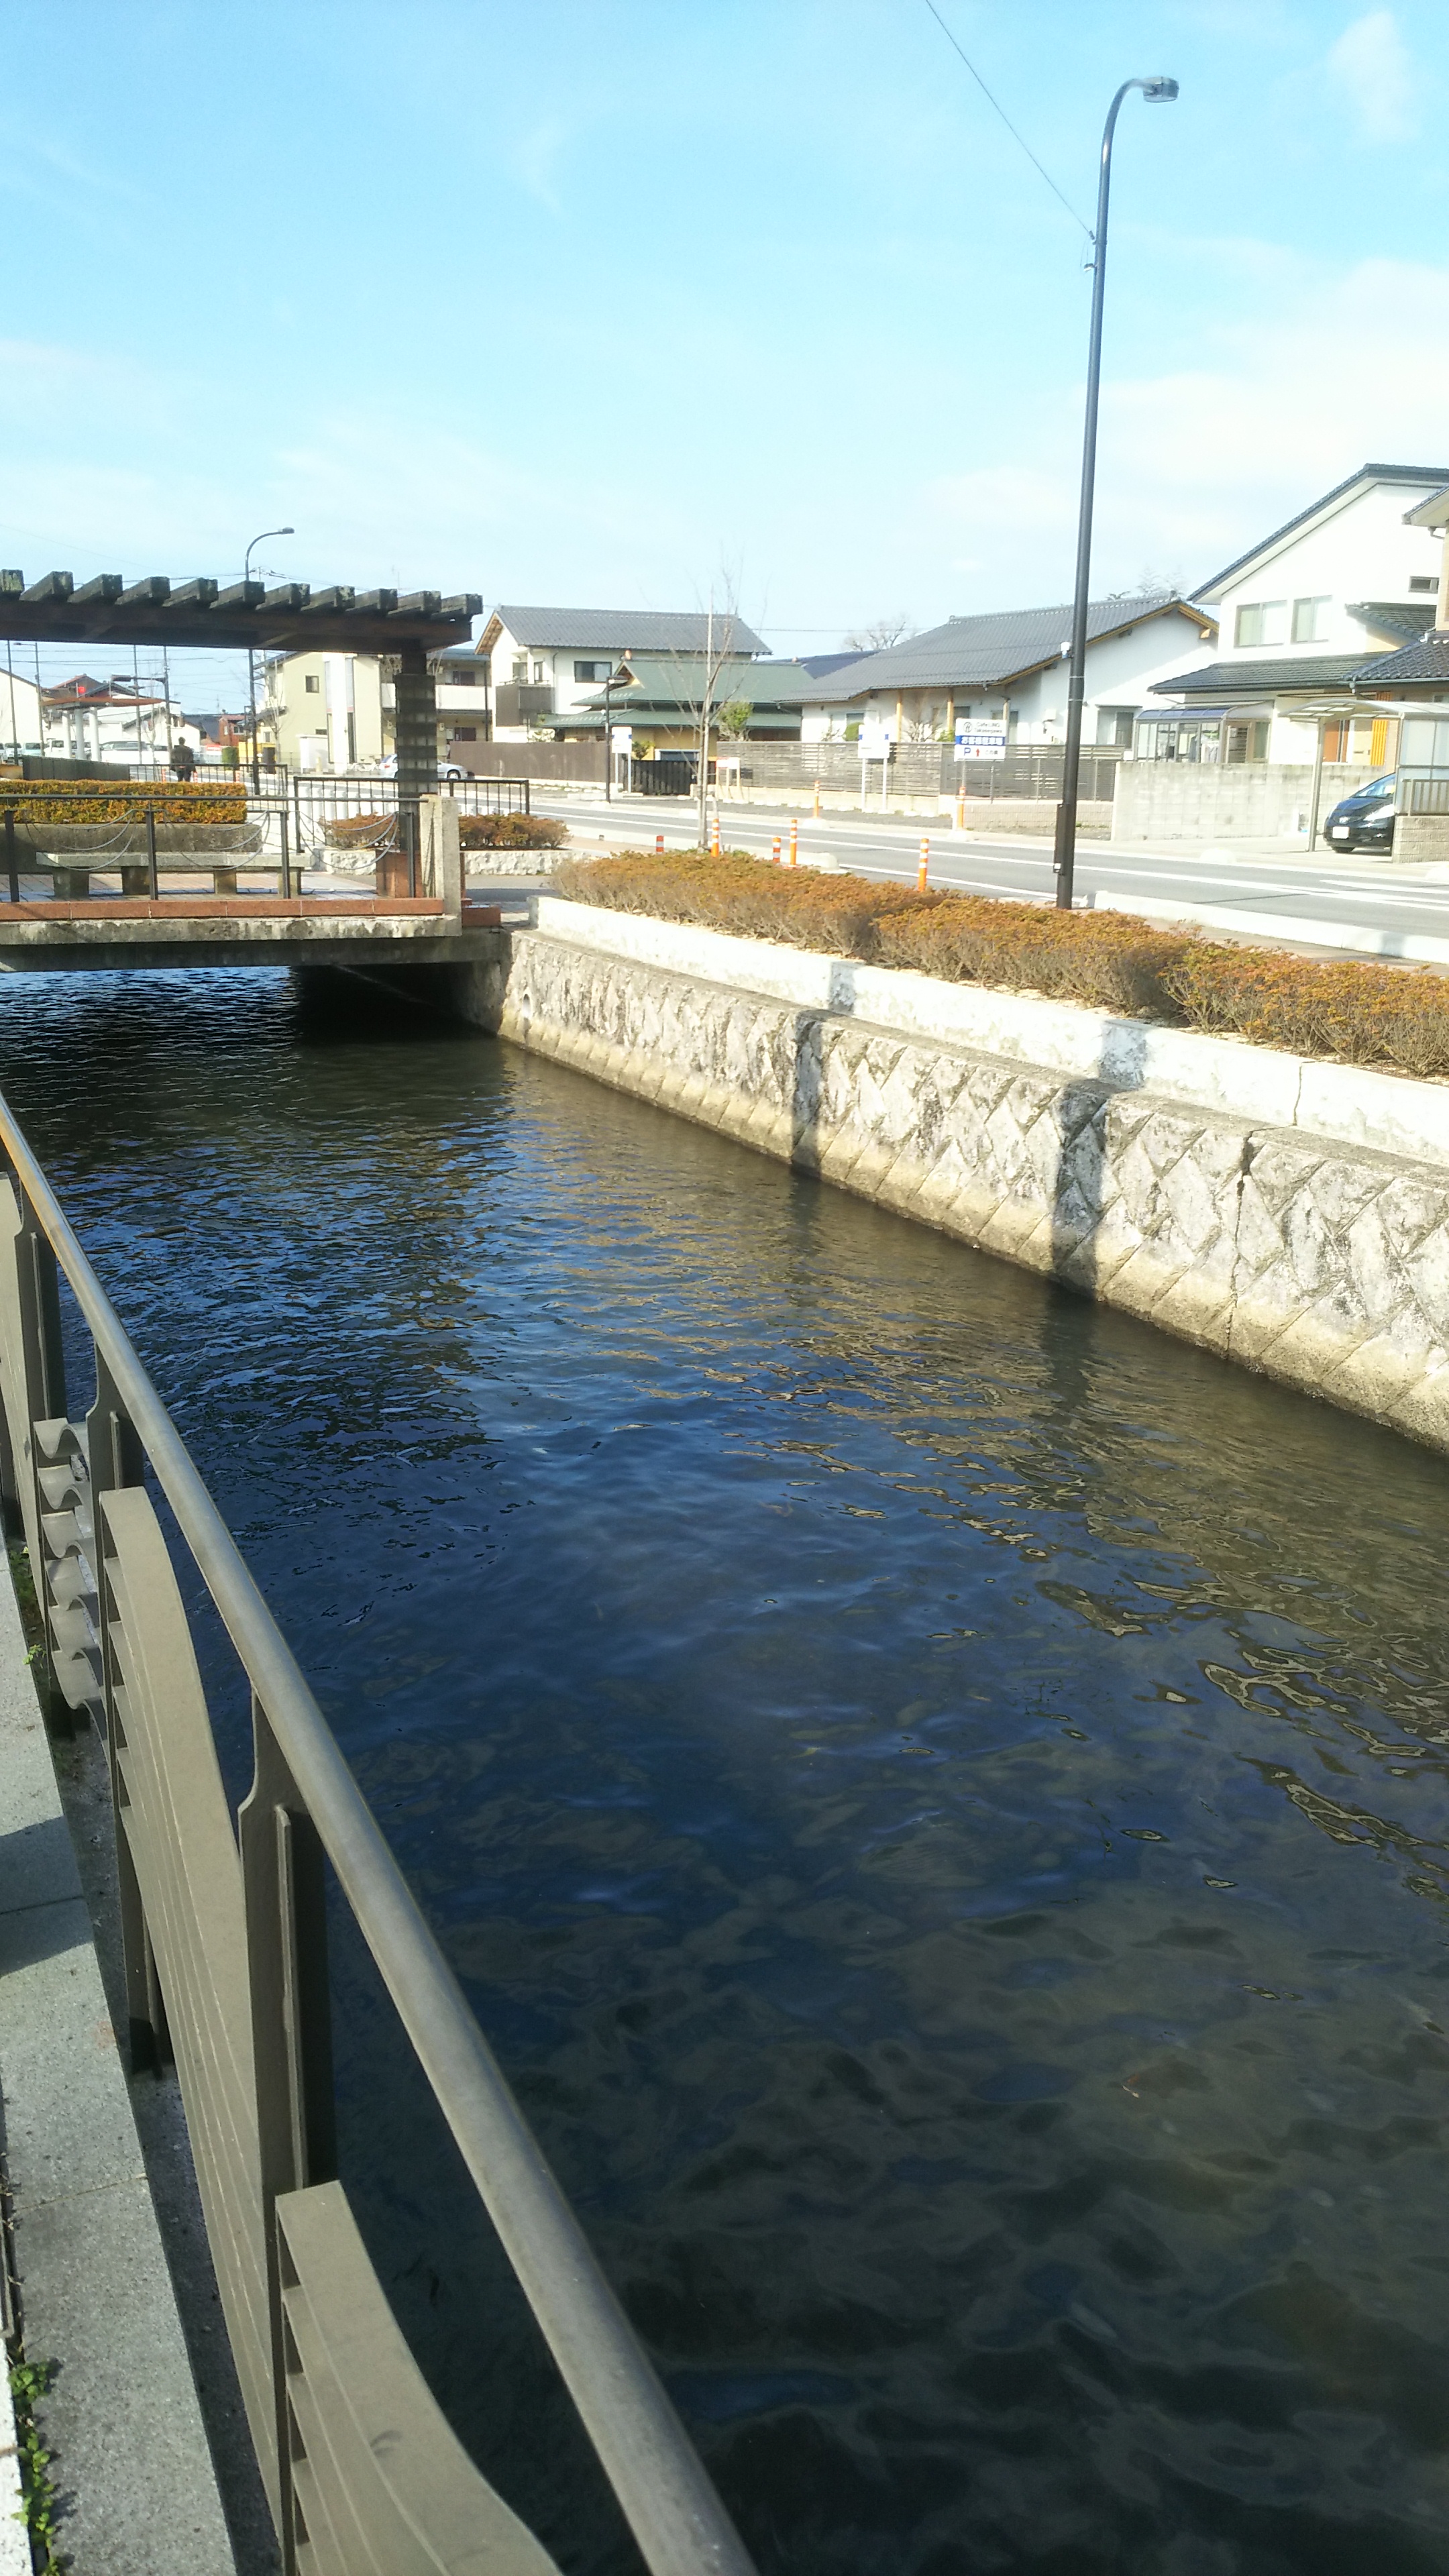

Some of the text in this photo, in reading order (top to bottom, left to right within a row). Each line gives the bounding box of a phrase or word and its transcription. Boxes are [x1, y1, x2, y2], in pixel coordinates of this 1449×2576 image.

[961, 737, 1003, 745] お客様駐車場
[964, 747, 971, 756] P
